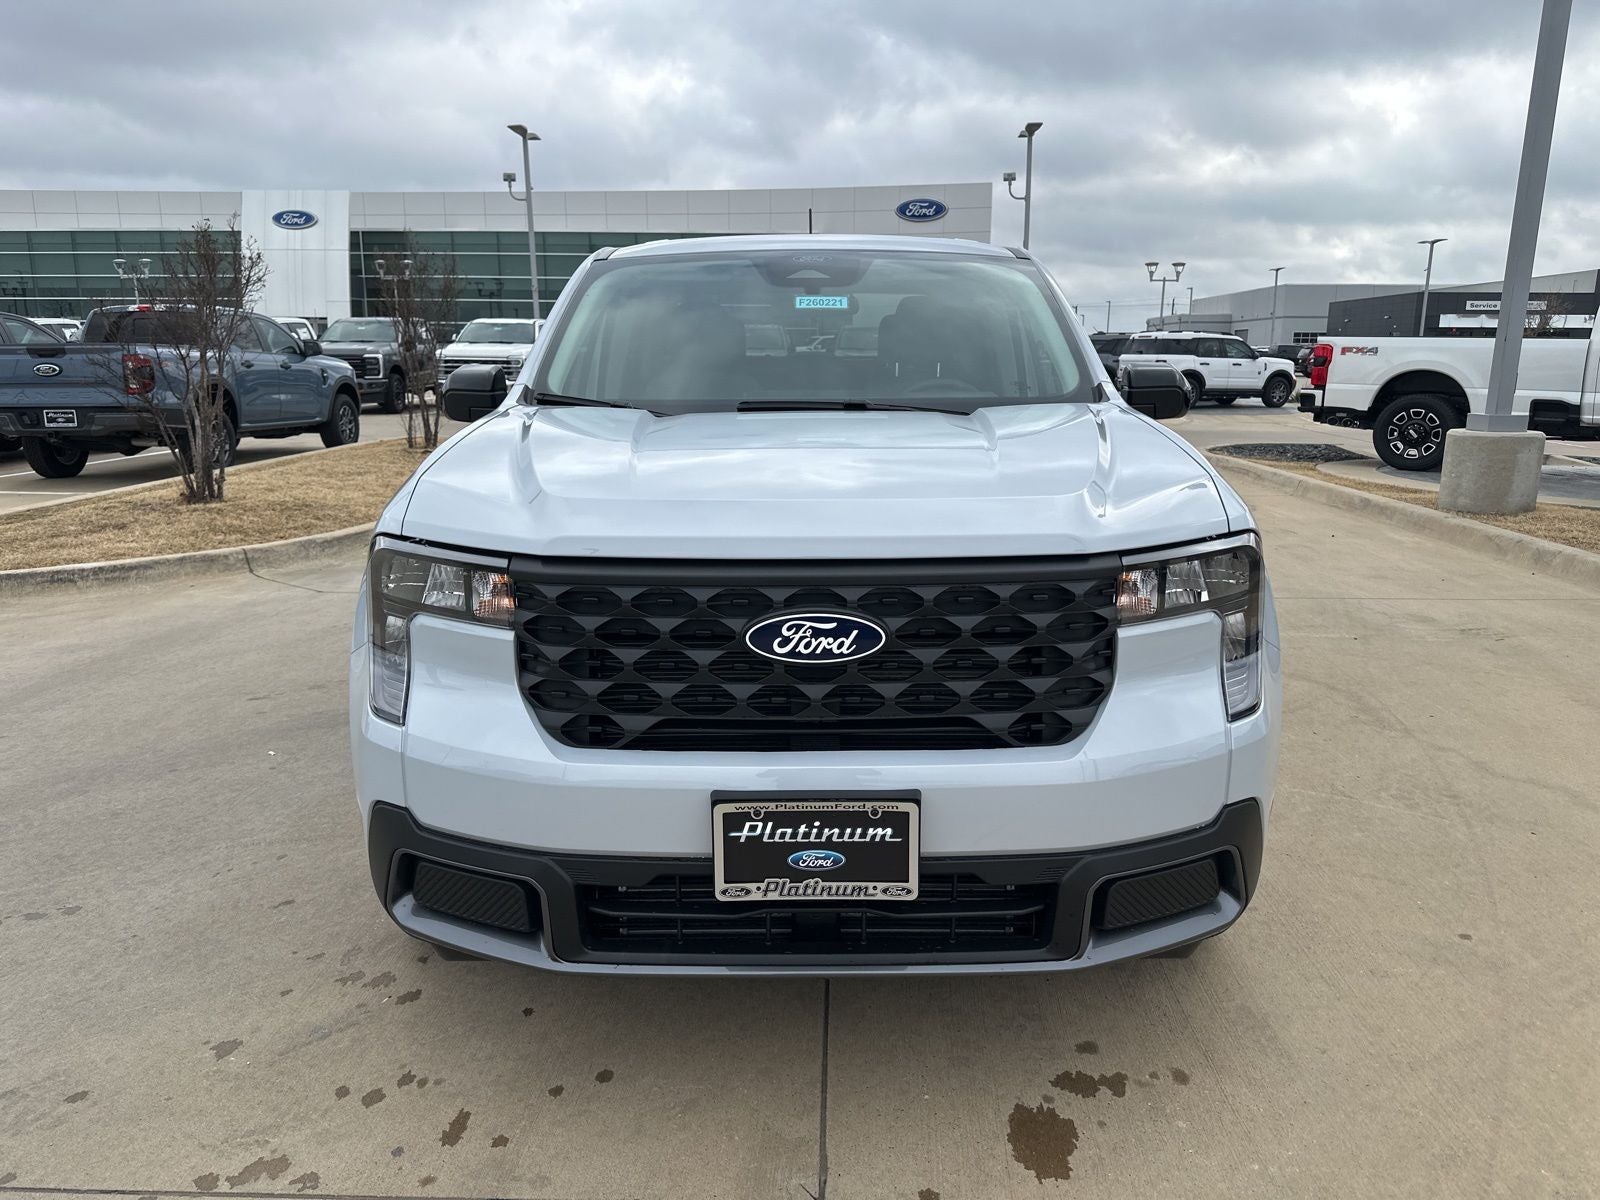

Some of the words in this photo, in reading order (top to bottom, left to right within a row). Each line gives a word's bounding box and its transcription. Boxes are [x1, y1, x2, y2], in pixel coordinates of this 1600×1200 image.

[906, 202, 936, 216] Ford
[280, 212, 307, 224] Ford
[799, 298, 843, 307] F260221
[1340, 346, 1379, 356] FX4
[773, 620, 859, 655] Ford
[734, 803, 899, 811] www.PlatinumFord.com
[728, 821, 903, 843] Platinum
[799, 852, 834, 867] Ford
[725, 887, 746, 897] Ford
[760, 880, 879, 898] Platinum
[886, 886, 908, 896] Ford
